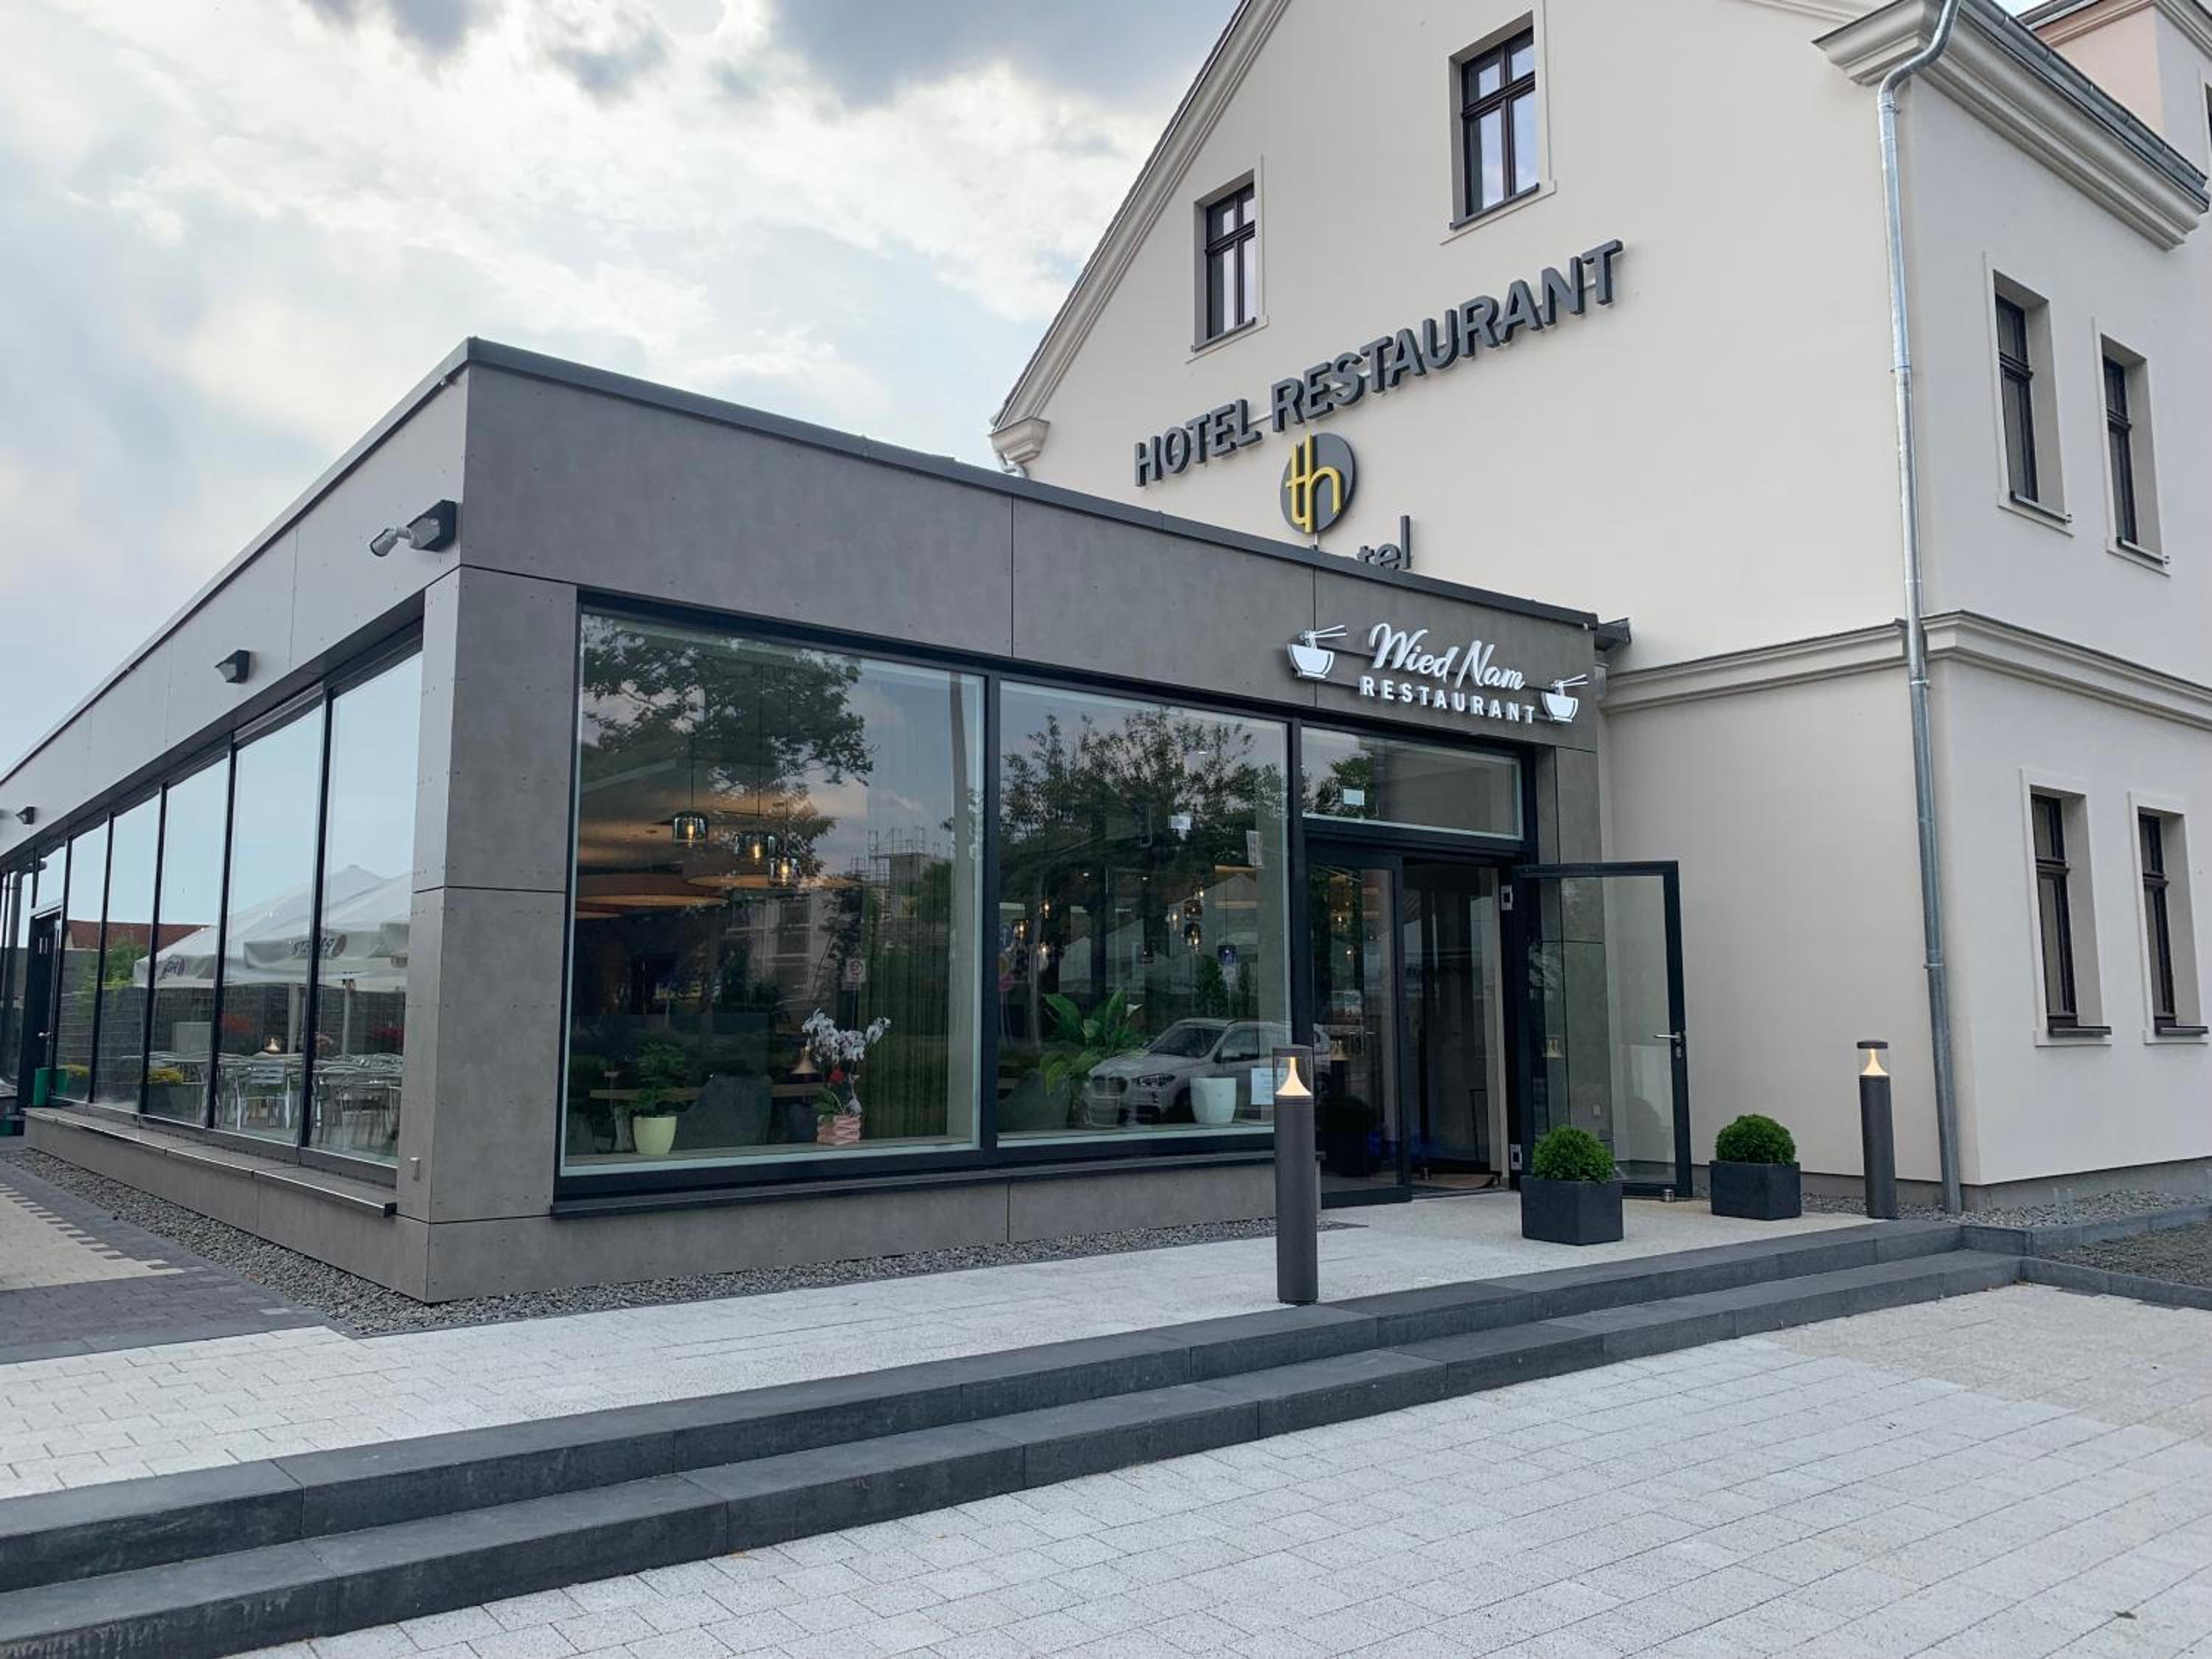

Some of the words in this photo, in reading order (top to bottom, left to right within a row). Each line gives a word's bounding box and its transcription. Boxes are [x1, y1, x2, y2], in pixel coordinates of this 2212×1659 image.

[1134, 398, 1263, 487] HOTEL
[1271, 239, 1624, 433] RESTAURANT
[1343, 515, 1412, 570] tel
[1368, 622, 1459, 684] Wied
[1453, 639, 1526, 691] Nam
[1359, 675, 1535, 724] RESTAURANT
